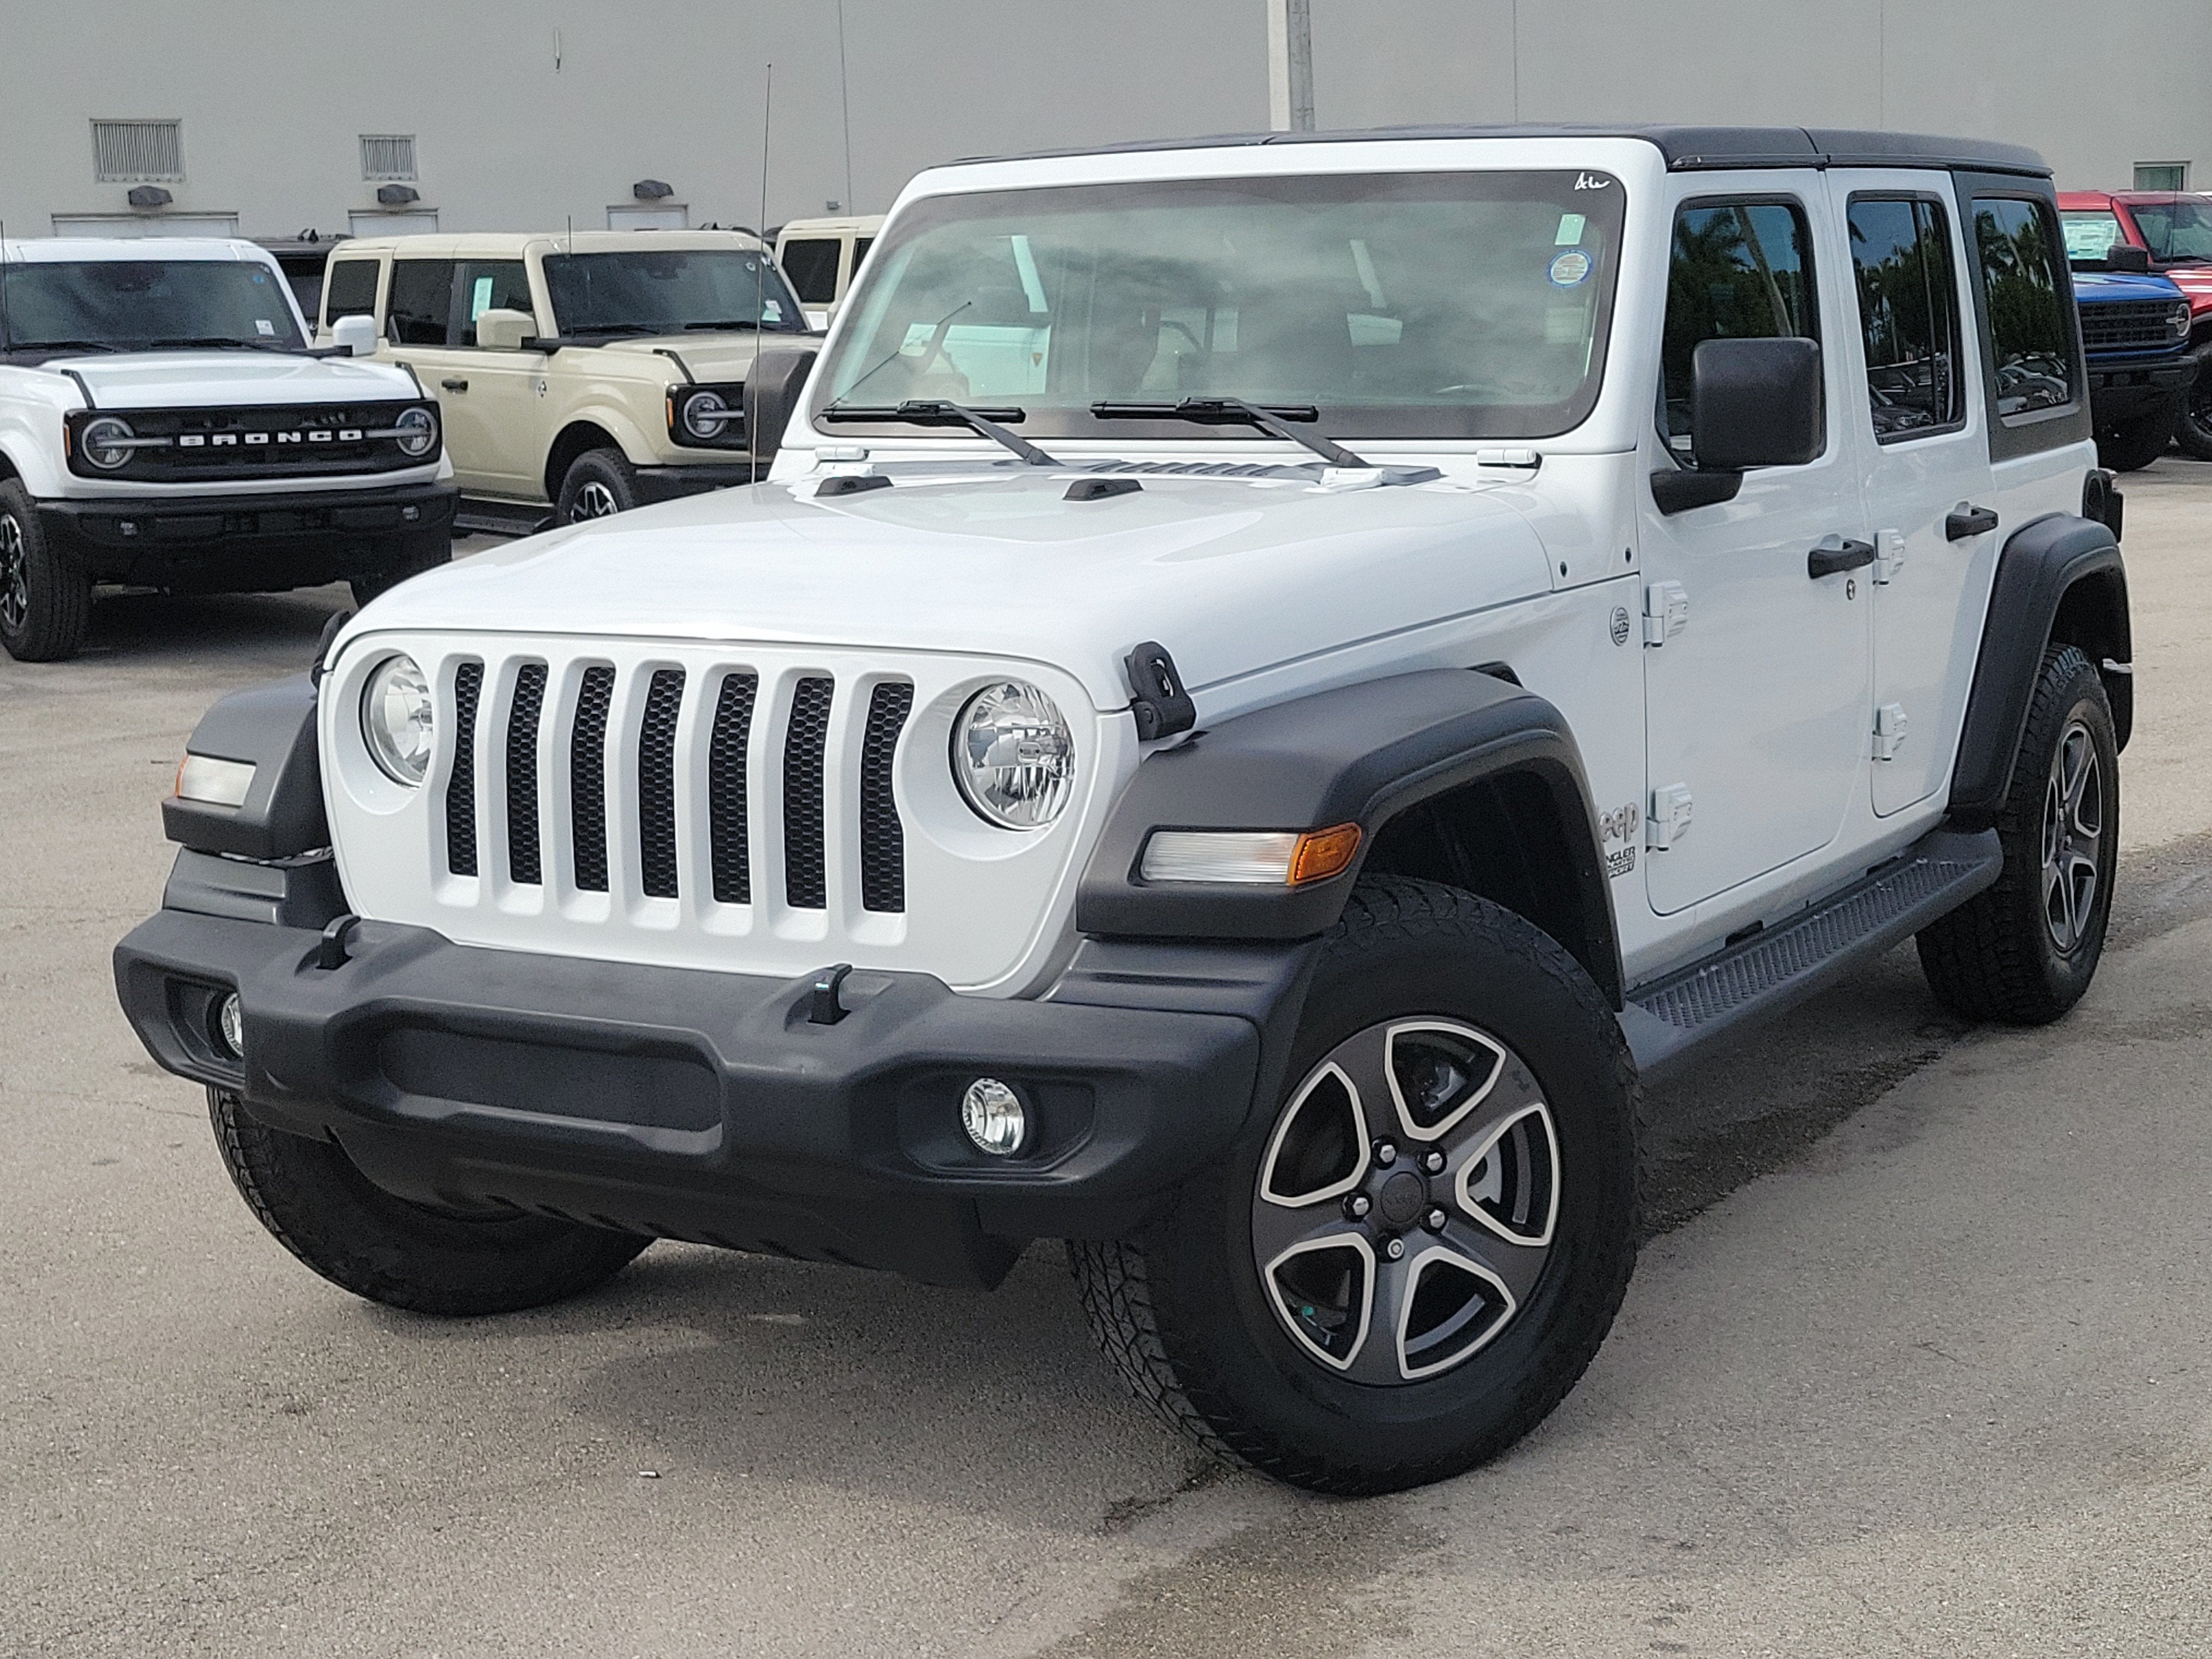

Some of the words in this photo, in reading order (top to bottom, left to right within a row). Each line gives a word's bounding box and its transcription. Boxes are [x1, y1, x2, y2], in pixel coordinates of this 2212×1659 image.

[179, 429, 362, 447] BRONCO
[1597, 802, 1639, 843] eep
[1606, 846, 1635, 862] NGLER
[1608, 863, 1633, 877] PORT
